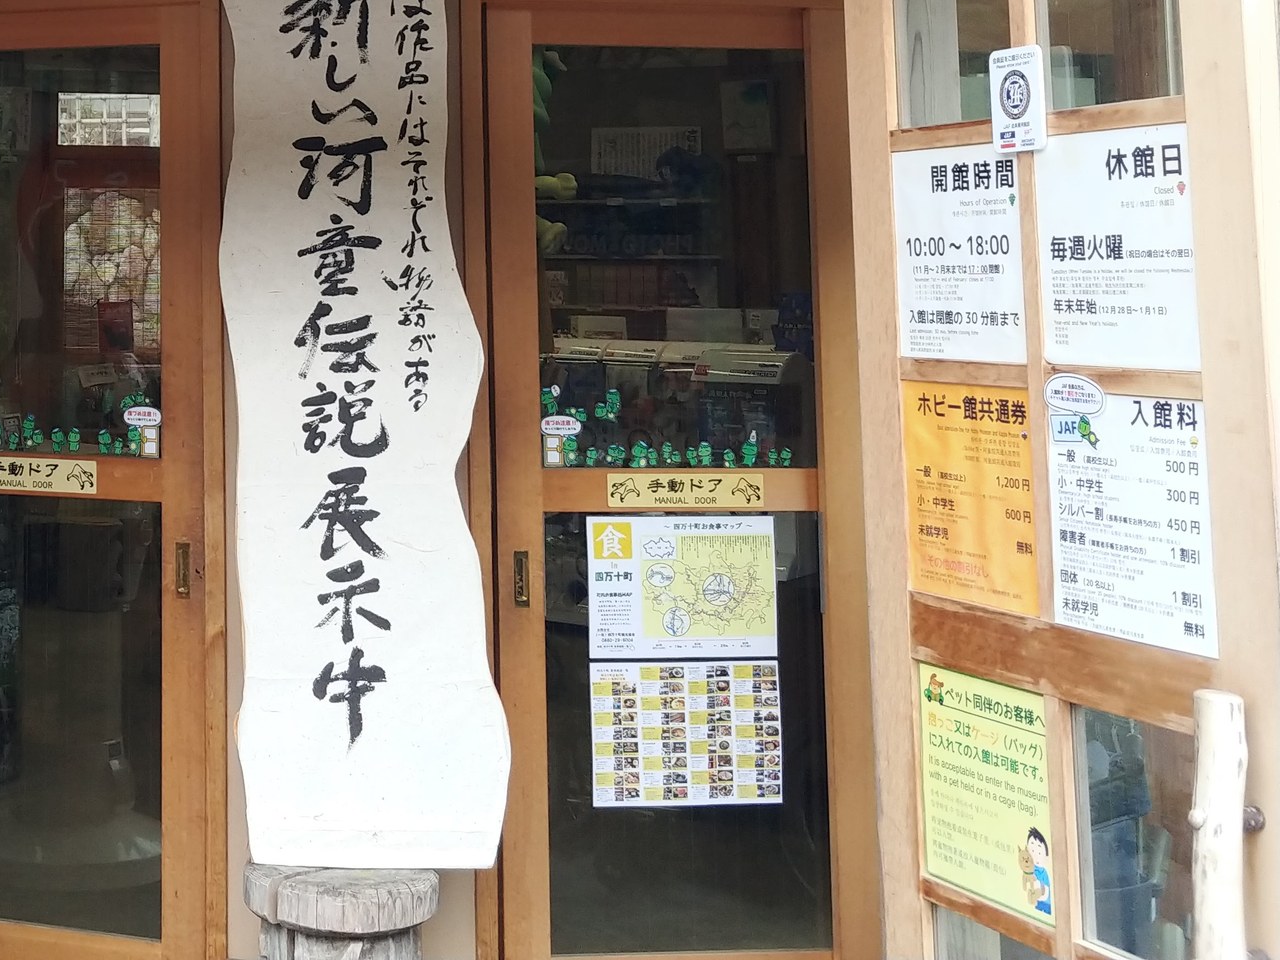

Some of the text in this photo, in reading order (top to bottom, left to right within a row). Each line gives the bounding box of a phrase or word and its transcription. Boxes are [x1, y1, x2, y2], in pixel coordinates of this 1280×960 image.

[1105, 144, 1182, 180] 休館日
[931, 159, 1014, 193] 開館時間
[1153, 186, 1174, 195] Closed
[975, 198, 981, 206] of
[982, 198, 1007, 206] Operation
[1050, 234, 1124, 262] 毎週火曜
[1053, 298, 1097, 315] 年末年始
[909, 310, 1019, 327] 入館は閉館の30分前まで
[917, 392, 1027, 425] ホビー館共通券
[1130, 400, 1198, 431] 入館料
[1057, 421, 1077, 435] JAF
[1148, 436, 1186, 446] Admission Fee
[1057, 449, 1076, 463] 一般
[916, 465, 931, 478] 一般
[1165, 460, 1199, 476] 500円
[32, 480, 53, 489] DOOR
[647, 478, 722, 493] 手動ドア
[996, 476, 1030, 492] 1,200円
[1057, 475, 1104, 493] 小・中学生
[654, 496, 689, 504] MANUAL
[917, 494, 955, 511] 小・中学生
[1166, 489, 1200, 505] 300円
[1005, 508, 1031, 524] 600円
[1058, 503, 1104, 521] シルバー割
[918, 524, 949, 540] 未就学児
[1167, 518, 1201, 535] 450円
[596, 524, 627, 558] 食
[1059, 529, 1086, 546] 障害者
[1016, 541, 1033, 556] 無料
[928, 555, 989, 578] その他の割引なし
[594, 571, 633, 582] 四万十町
[1060, 569, 1079, 585] 団体
[1062, 597, 1099, 617] 未就学児
[1183, 621, 1205, 639] 無料
[945, 688, 1045, 728] ペット同伴のお客様へ
[929, 732, 1044, 783] に入れての入館は可能です。
[941, 759, 975, 779] acceptable
[977, 771, 984, 782] to
[985, 774, 1003, 788] enter
[1004, 781, 1016, 793] the
[1017, 786, 1048, 804] museum
[929, 770, 942, 782] with
[949, 777, 959, 788] pet
[960, 779, 975, 793] held
[976, 787, 983, 795] or
[984, 789, 991, 799] in
[992, 792, 997, 801] a
[999, 795, 1016, 808] cage
[1018, 800, 1038, 817] (bag).
